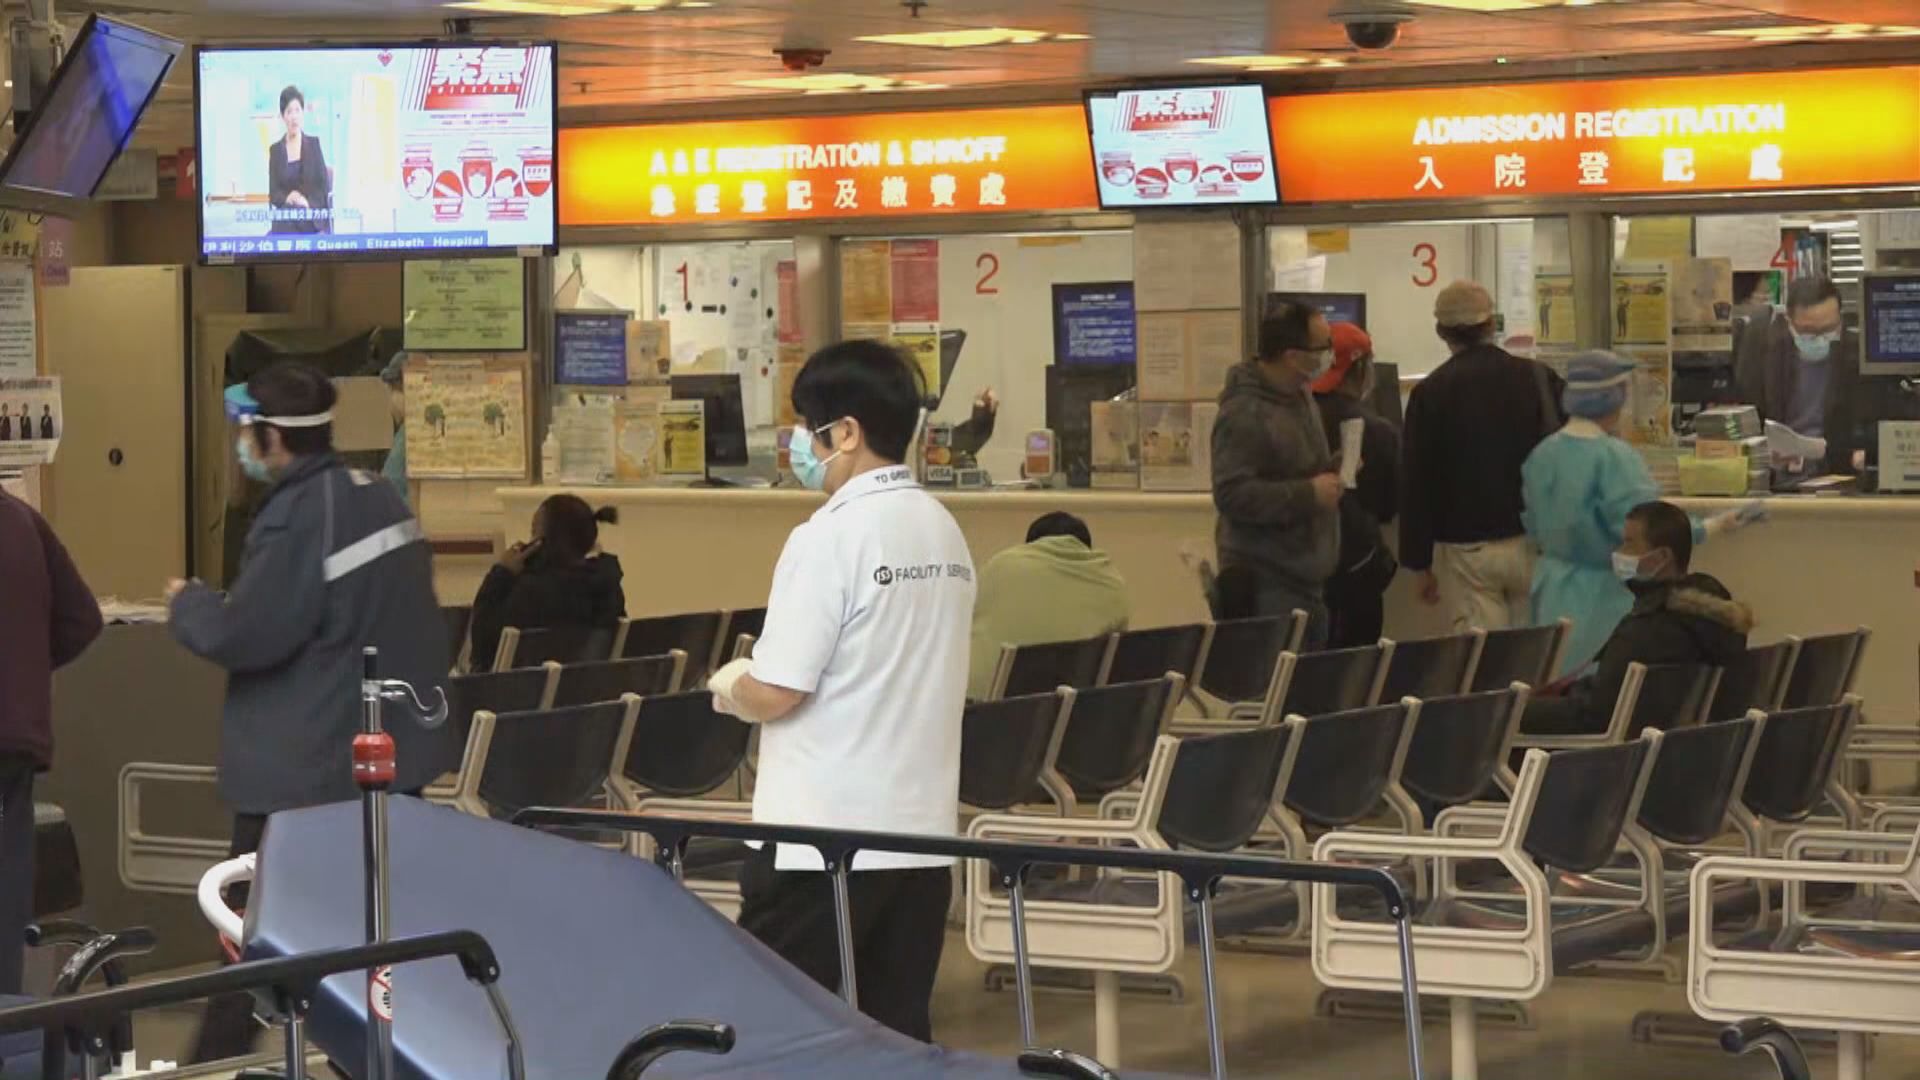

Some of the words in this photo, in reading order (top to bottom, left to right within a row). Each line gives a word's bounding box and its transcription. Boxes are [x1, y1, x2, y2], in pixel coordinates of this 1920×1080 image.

[1413, 111, 1566, 145] ADMISSION
[1574, 103, 1786, 139] REGISTRATION
[650, 148, 667, 176] A
[717, 141, 881, 173] REGISTRATION
[910, 136, 1007, 165] SHROFF
[317, 239, 358, 250] Queen
[367, 237, 425, 249] Elizabeth
[433, 235, 484, 248] Hospital
[1770, 231, 1799, 283] 4
[676, 261, 688, 302] 1
[976, 252, 999, 295] 2
[1412, 242, 1438, 287] 3
[929, 467, 952, 479] VISA
[896, 563, 942, 582] FACILITY
